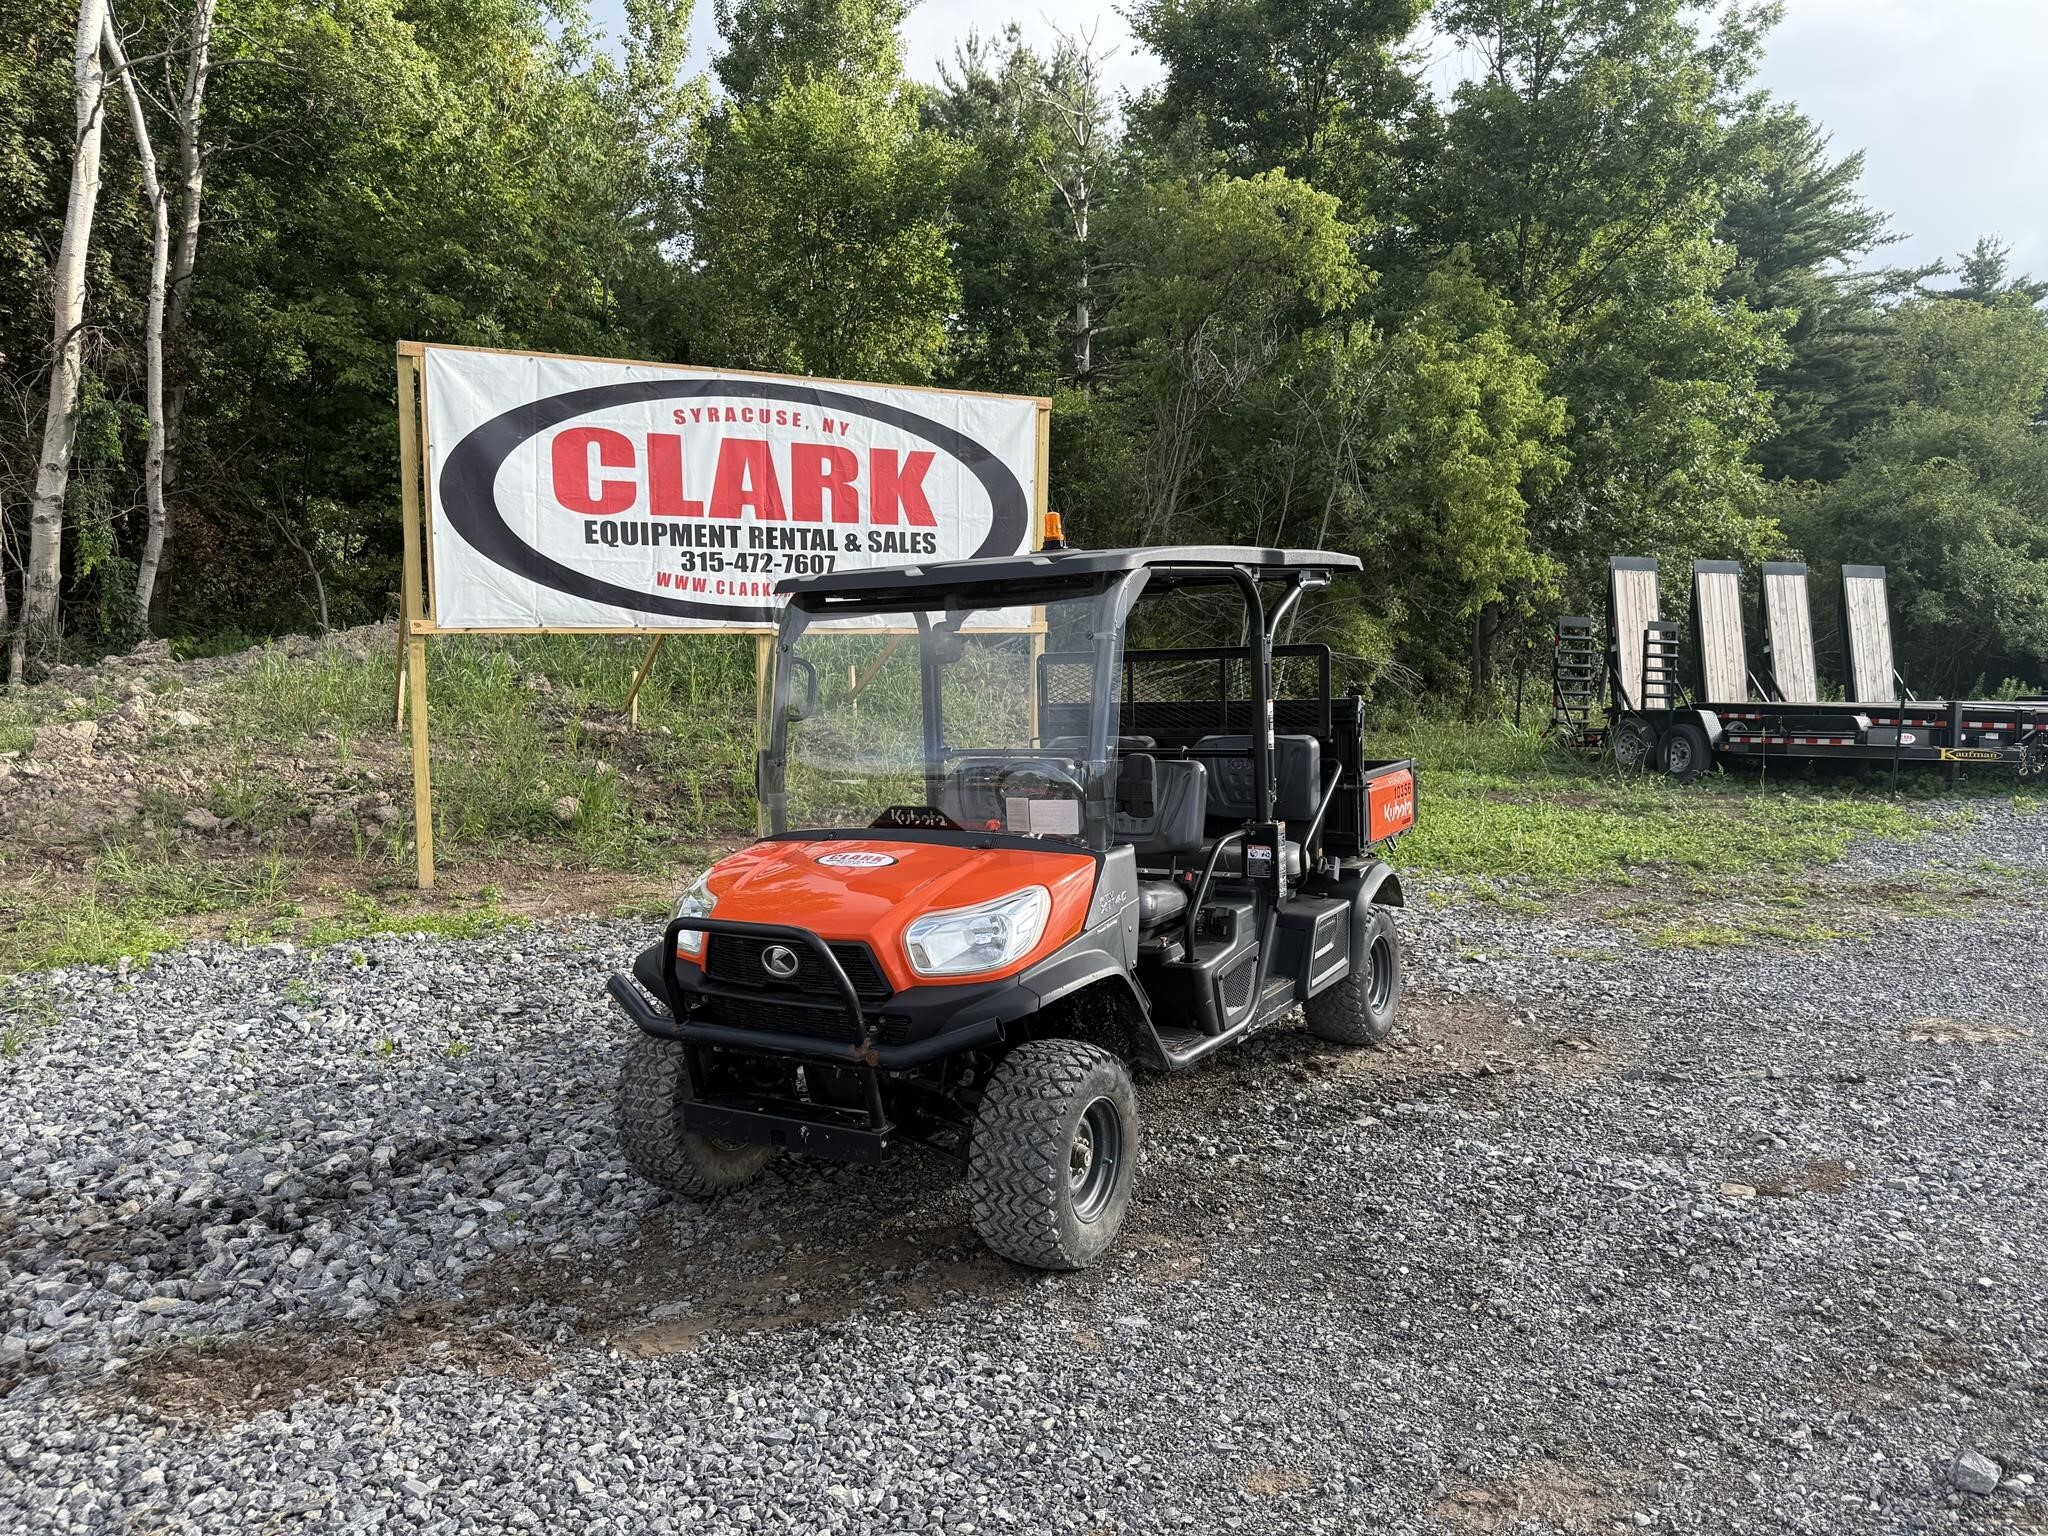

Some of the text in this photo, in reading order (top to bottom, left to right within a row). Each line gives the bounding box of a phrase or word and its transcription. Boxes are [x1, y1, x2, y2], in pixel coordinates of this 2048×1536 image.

[673, 407, 851, 436] SYRACUSE, NY
[551, 426, 938, 527] CLARK
[584, 519, 937, 554] EQUIPMENT RENTAL & SALES
[680, 551, 837, 575] 315-472-7607
[1940, 747, 1998, 760] Kaufman
[890, 808, 947, 826] Kubota
